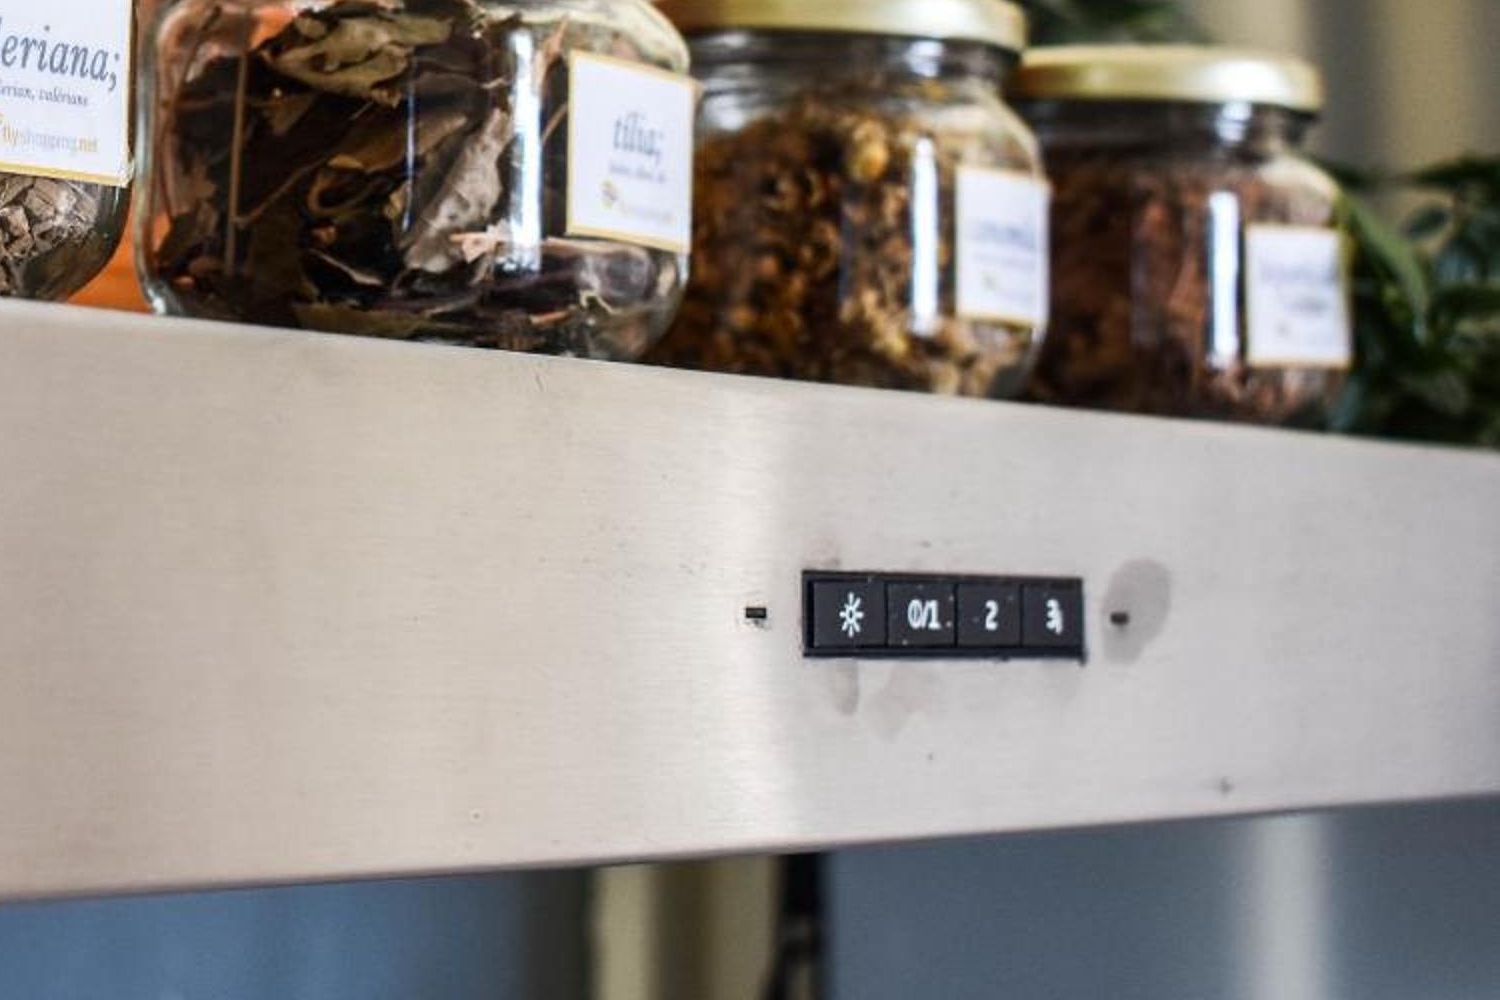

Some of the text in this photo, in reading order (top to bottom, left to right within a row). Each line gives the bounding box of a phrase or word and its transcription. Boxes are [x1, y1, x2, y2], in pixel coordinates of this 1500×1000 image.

[907, 598, 1063, 635] 0/1 2 3
